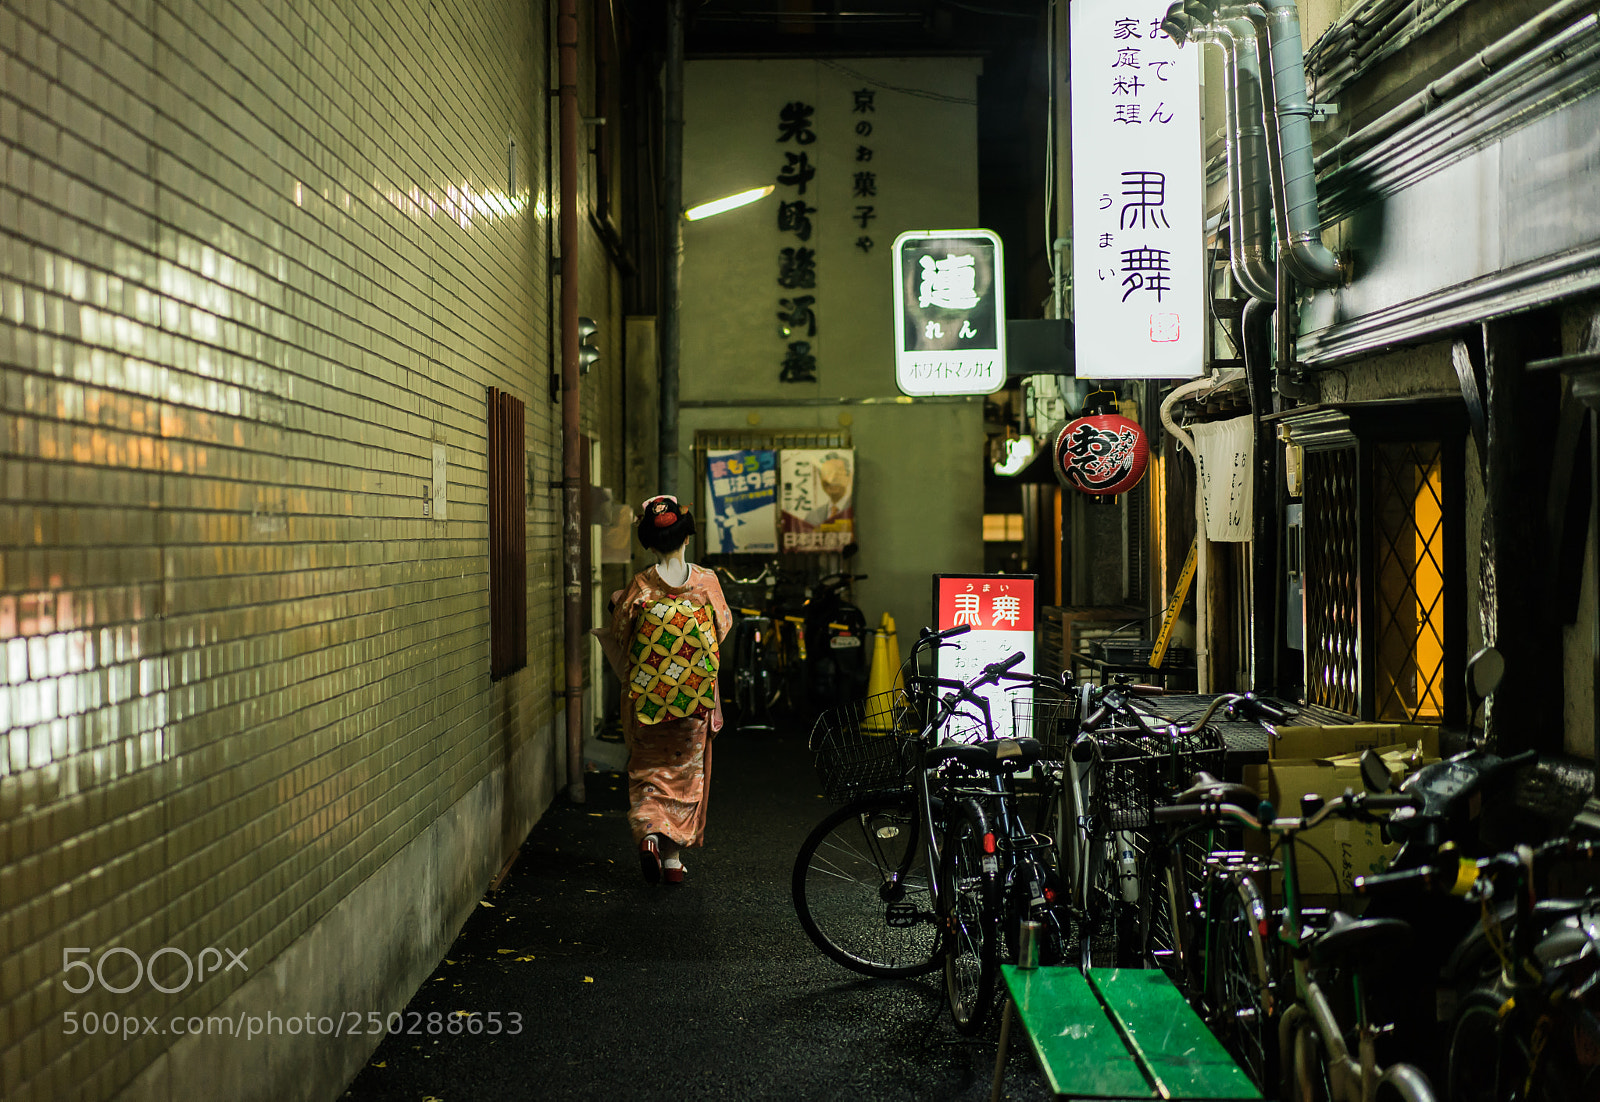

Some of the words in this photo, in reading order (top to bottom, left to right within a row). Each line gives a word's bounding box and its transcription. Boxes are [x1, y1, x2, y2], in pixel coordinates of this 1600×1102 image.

[1111, 17, 1145, 125] 家庭料理
[1149, 17, 1176, 124] おでん
[852, 87, 877, 253] 京のお菓子や
[1099, 194, 1116, 281] うまい
[925, 320, 977, 340] れん
[909, 360, 993, 379] ホワイトマッカイ
[710, 453, 775, 478] まもろう
[966, 583, 1010, 592] うまい
